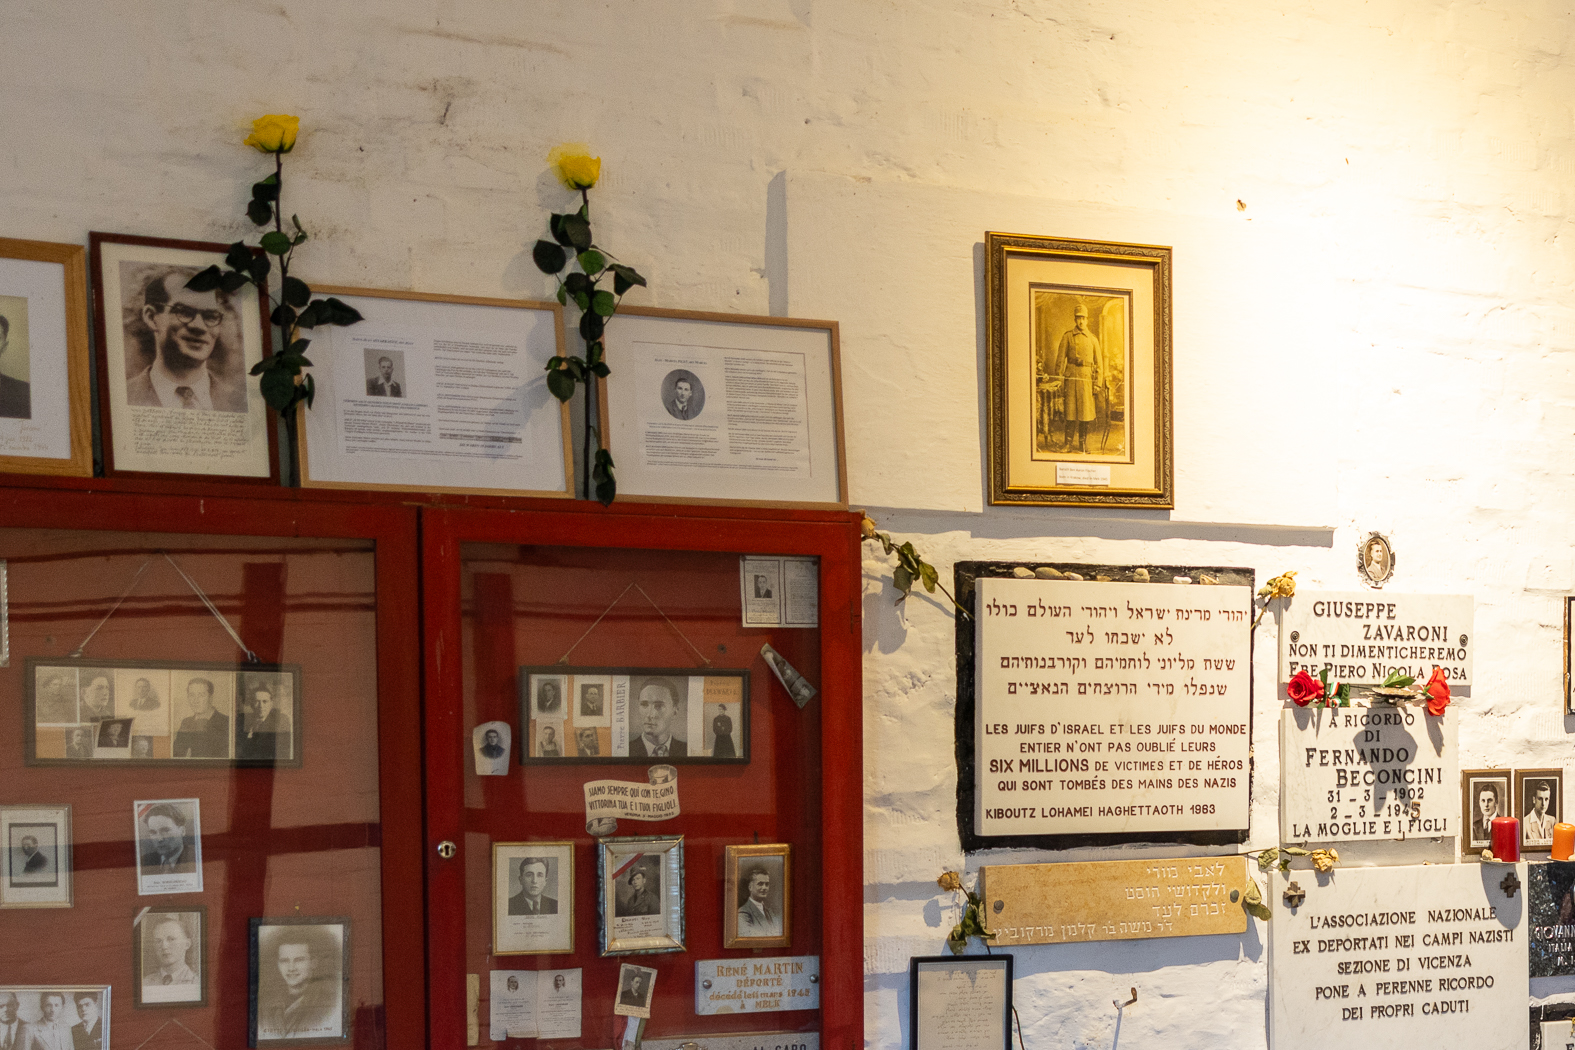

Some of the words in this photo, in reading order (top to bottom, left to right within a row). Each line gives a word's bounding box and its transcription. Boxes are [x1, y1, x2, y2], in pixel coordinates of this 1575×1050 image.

[1313, 601, 1396, 619] GIUSEPPE
[1105, 632, 1145, 644] ישכחו
[1154, 627, 1173, 645] לא
[1363, 624, 1448, 642] ZAVARONI
[1095, 652, 1150, 669] לוחמיהם
[1158, 652, 1194, 670] מליוני
[1289, 644, 1317, 657] NON
[1323, 645, 1335, 657] TI
[1341, 645, 1466, 661] DIMENTICHEREMO
[1001, 656, 1086, 675] וקורבנותיהם
[1204, 659, 1235, 670] ששת
[1008, 682, 1068, 694] הנאציים
[1078, 682, 1137, 695] הרוצחים
[1148, 683, 1174, 695] מידי
[1184, 677, 1227, 696] שנפלו
[986, 724, 1008, 735] LES
[1015, 724, 1045, 734] JUIFS
[1051, 722, 1104, 734] D'ISRAEL
[1110, 724, 1124, 734] ET
[1130, 724, 1151, 734] LES
[1157, 724, 1185, 734] JUIFS
[1191, 724, 1204, 734] DU
[1209, 724, 1246, 735] MONDE
[1329, 715, 1337, 727] A
[1345, 714, 1415, 727] RICORDO
[1365, 730, 1380, 742] DI
[1020, 743, 1060, 753] ENTIER
[1067, 740, 1102, 752] N'ONT
[1108, 742, 1131, 752] PAS
[1137, 738, 1175, 752] OUBLIÉ
[1181, 742, 1215, 752] LEURS
[990, 759, 1013, 773] SIX
[1019, 759, 1089, 772] MILLIONS
[1095, 761, 1108, 771] DE
[1115, 761, 1163, 771] VICTIMES
[1169, 760, 1182, 771] ET
[1188, 760, 1202, 770] DE
[1207, 756, 1243, 770] HÉROS
[1306, 747, 1409, 767] FERNANDO
[998, 781, 1016, 792] QUI
[1022, 780, 1053, 791] SONT
[1060, 775, 1106, 790] TOMBÉS
[1112, 779, 1133, 790] DES
[1138, 779, 1173, 789] MAINS
[1178, 778, 1198, 788] DES
[1204, 777, 1237, 788] NAZIS
[1336, 768, 1442, 787] BECONCINI
[607, 786, 628, 796] SEMPRE
[1328, 791, 1340, 802] 31
[1364, 790, 1371, 801] 3
[1393, 787, 1424, 800] 1902
[589, 800, 617, 810] VITTORINA
[618, 800, 628, 810] TUA
[986, 808, 1036, 819] KIBOUTZ
[1041, 807, 1093, 818] LOHAMEI
[1098, 805, 1183, 816] HAGHETTAOTH
[1190, 804, 1215, 815] 1963
[1331, 807, 1337, 819] 2
[1359, 806, 1365, 817] 3
[1387, 801, 1420, 819] 1945
[1293, 823, 1311, 837] LA
[1317, 821, 1376, 836] MOGLIE
[1384, 822, 1391, 833] E
[1408, 818, 1446, 833] FIGLI
[1310, 911, 1416, 929] L'ASSOCIAZIONE
[1428, 907, 1497, 922] NAZIONALE
[1293, 941, 1310, 954] EX
[1318, 936, 1388, 952] DEPORTATI
[1395, 935, 1414, 948] NEI
[1423, 932, 1463, 947] CAMPI
[1469, 929, 1513, 944] NAZISTI
[717, 963, 747, 977] RENÉ
[754, 963, 803, 975] MARTIN
[1338, 960, 1390, 974] SEZIONE
[1397, 958, 1410, 971] DI
[1418, 955, 1472, 969] VICENZA
[737, 976, 782, 987] DÉPORTÉ
[1316, 985, 1349, 1000] PONE
[1358, 984, 1366, 997] A
[1376, 980, 1432, 996] PERENNE
[1439, 976, 1494, 991] RICORDO
[1342, 1007, 1362, 1020] DEI
[1371, 1004, 1414, 1018] PROPRI
[1422, 1000, 1469, 1015] CADUTI
